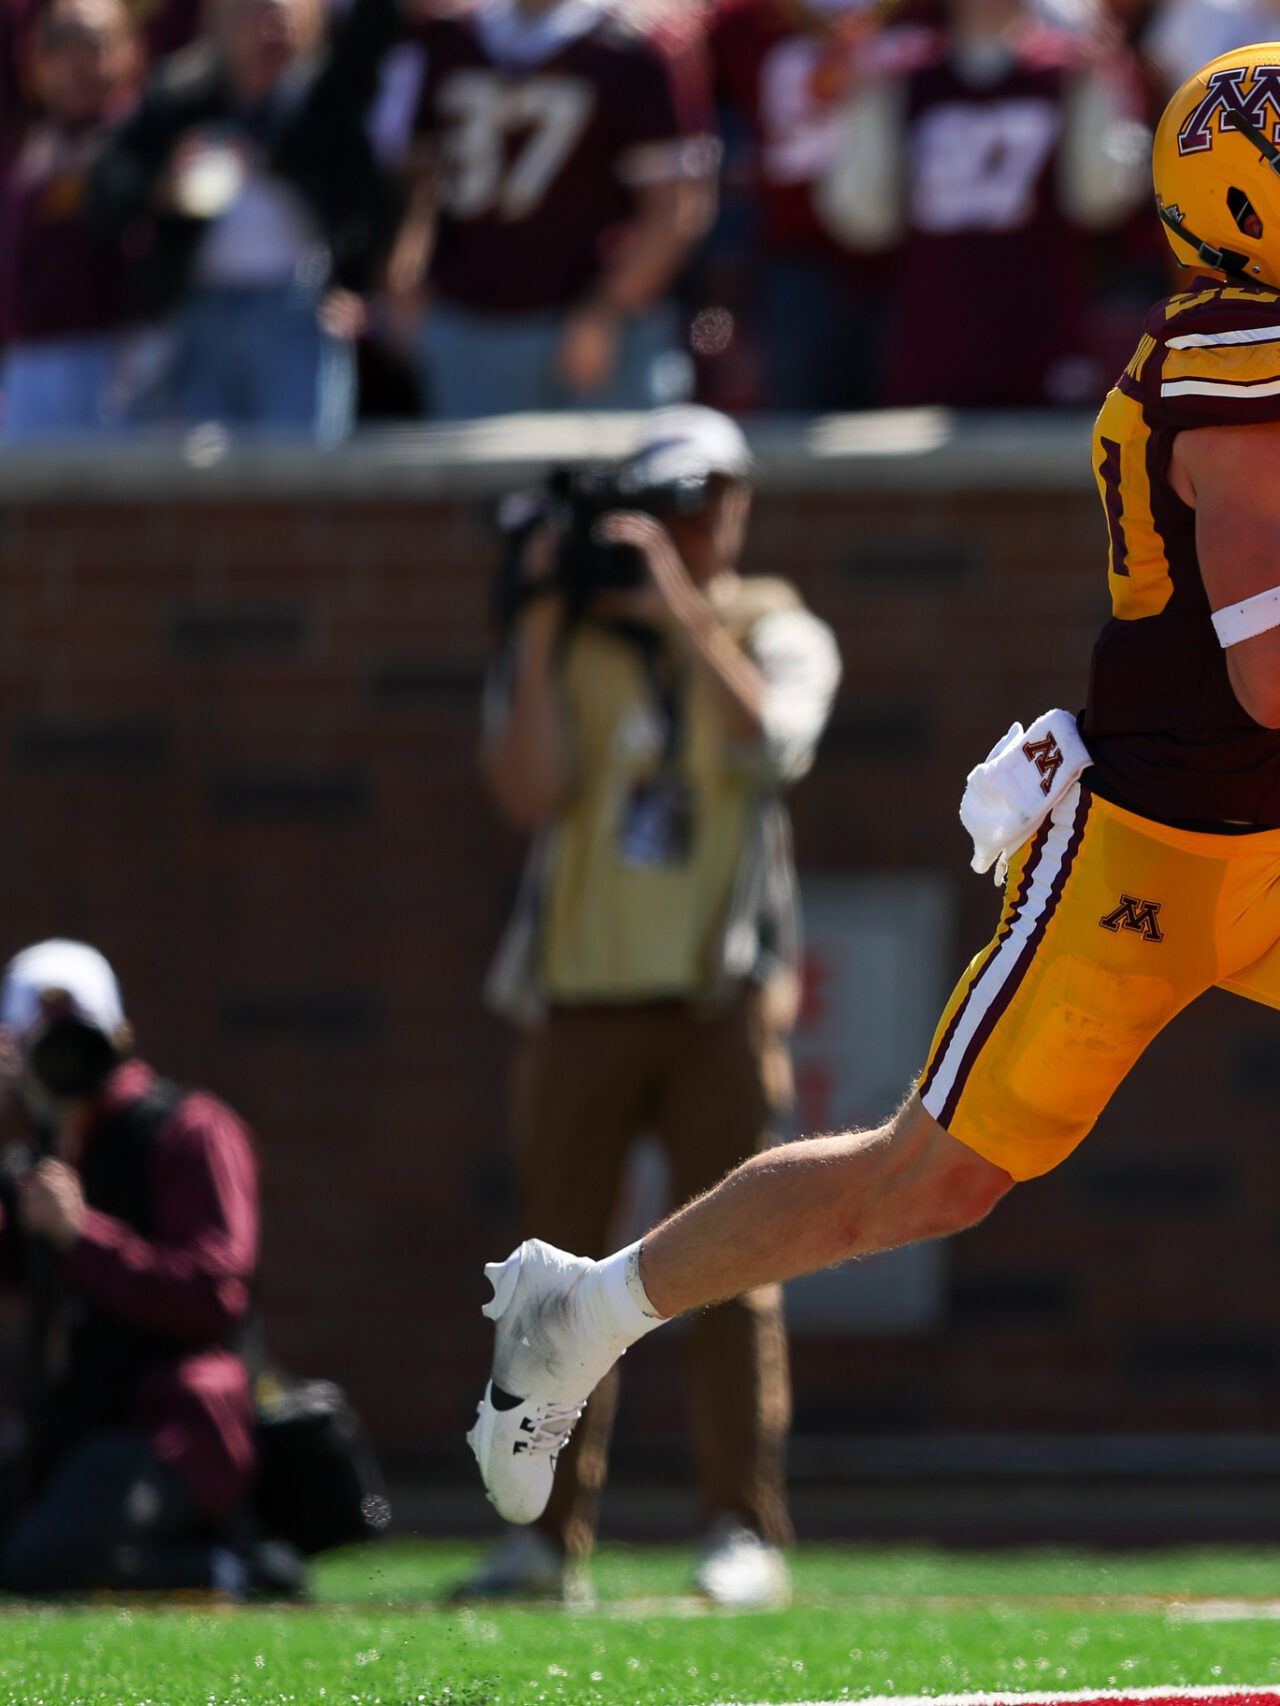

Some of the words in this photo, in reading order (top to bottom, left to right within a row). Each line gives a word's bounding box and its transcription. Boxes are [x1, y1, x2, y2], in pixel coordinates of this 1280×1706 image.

[436, 72, 596, 222] 37
[1023, 731, 1063, 796] M
[1099, 894, 1163, 943] M
